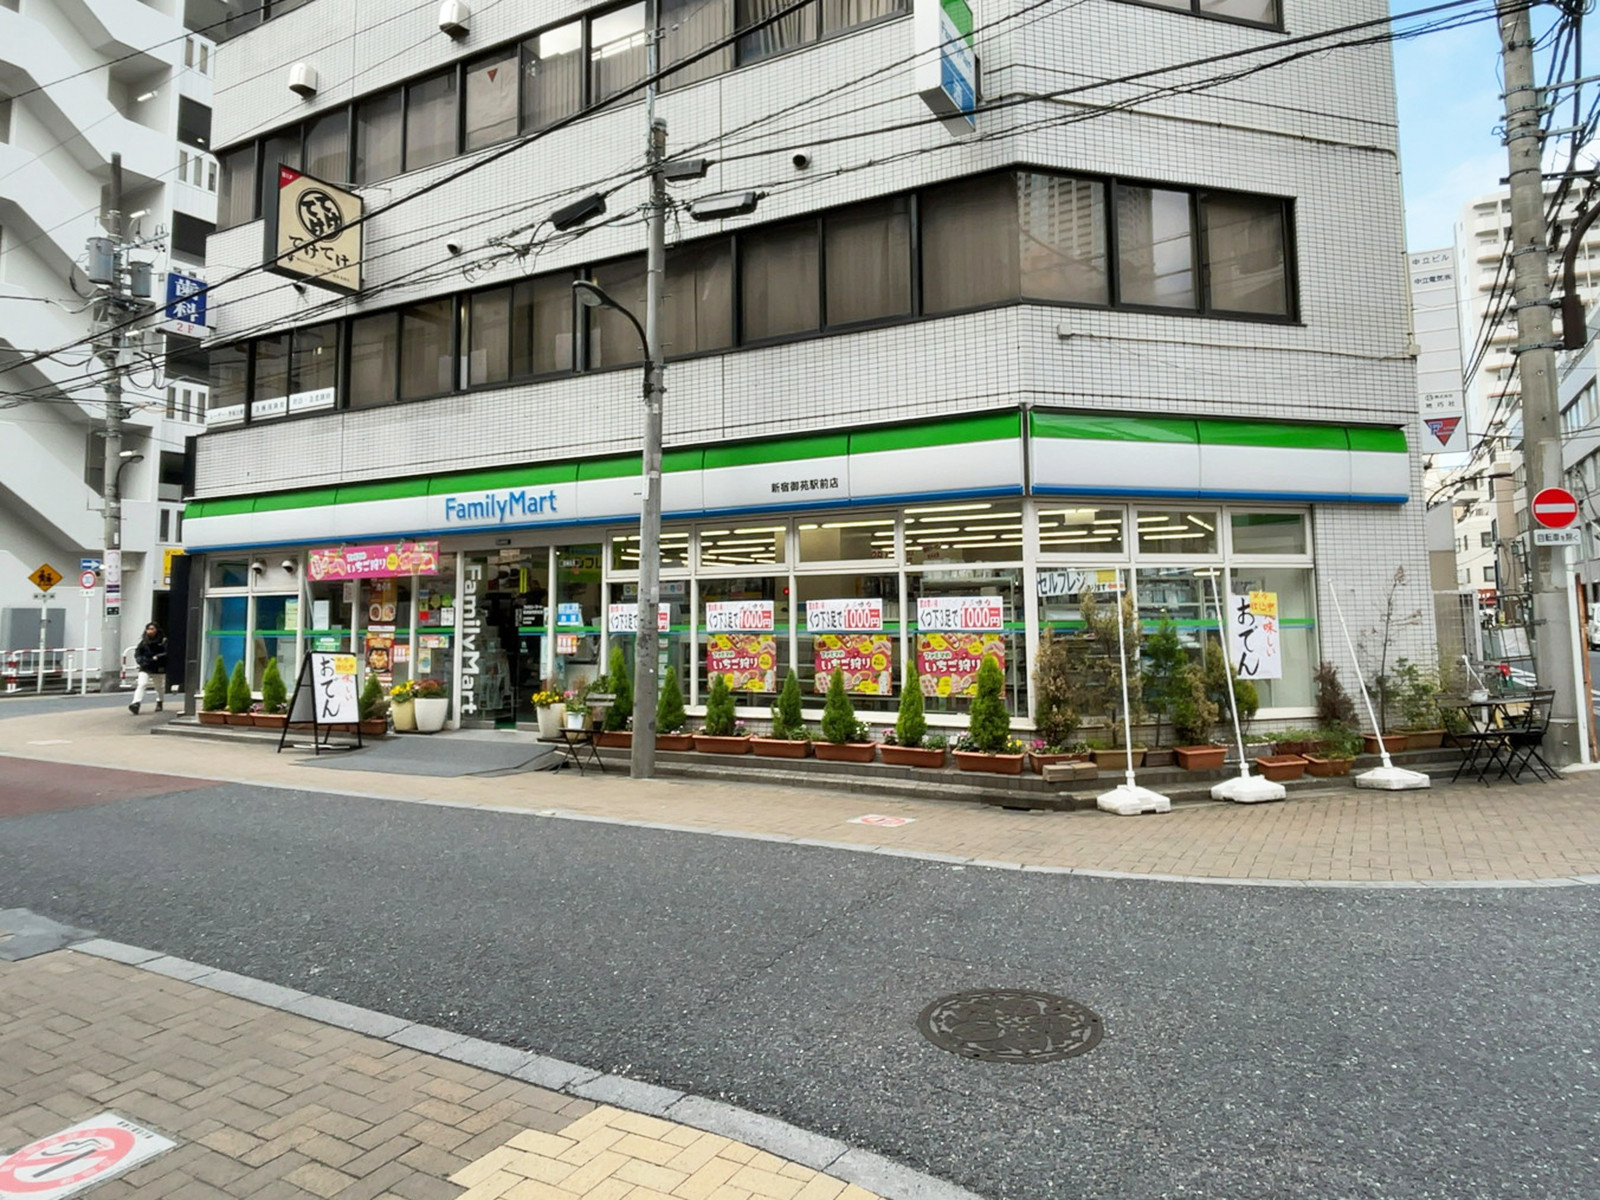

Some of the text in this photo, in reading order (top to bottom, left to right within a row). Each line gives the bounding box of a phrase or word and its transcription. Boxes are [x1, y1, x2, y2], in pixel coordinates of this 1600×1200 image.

[1412, 254, 1450, 265] 中立ビル
[173, 278, 200, 323] 歯科
[771, 477, 839, 493] 新宿御苑駅前店
[445, 489, 557, 523] FamilyMart
[1537, 533, 1579, 543] 自転車を除く
[1037, 571, 1086, 595] セルフレジ
[461, 564, 482, 715] FamilyMart
[1236, 597, 1260, 676] おでん
[1262, 615, 1277, 657] 味しい
[712, 657, 758, 670] いちご狩り
[924, 659, 981, 672] いちご狩り
[320, 656, 341, 719] おでん
